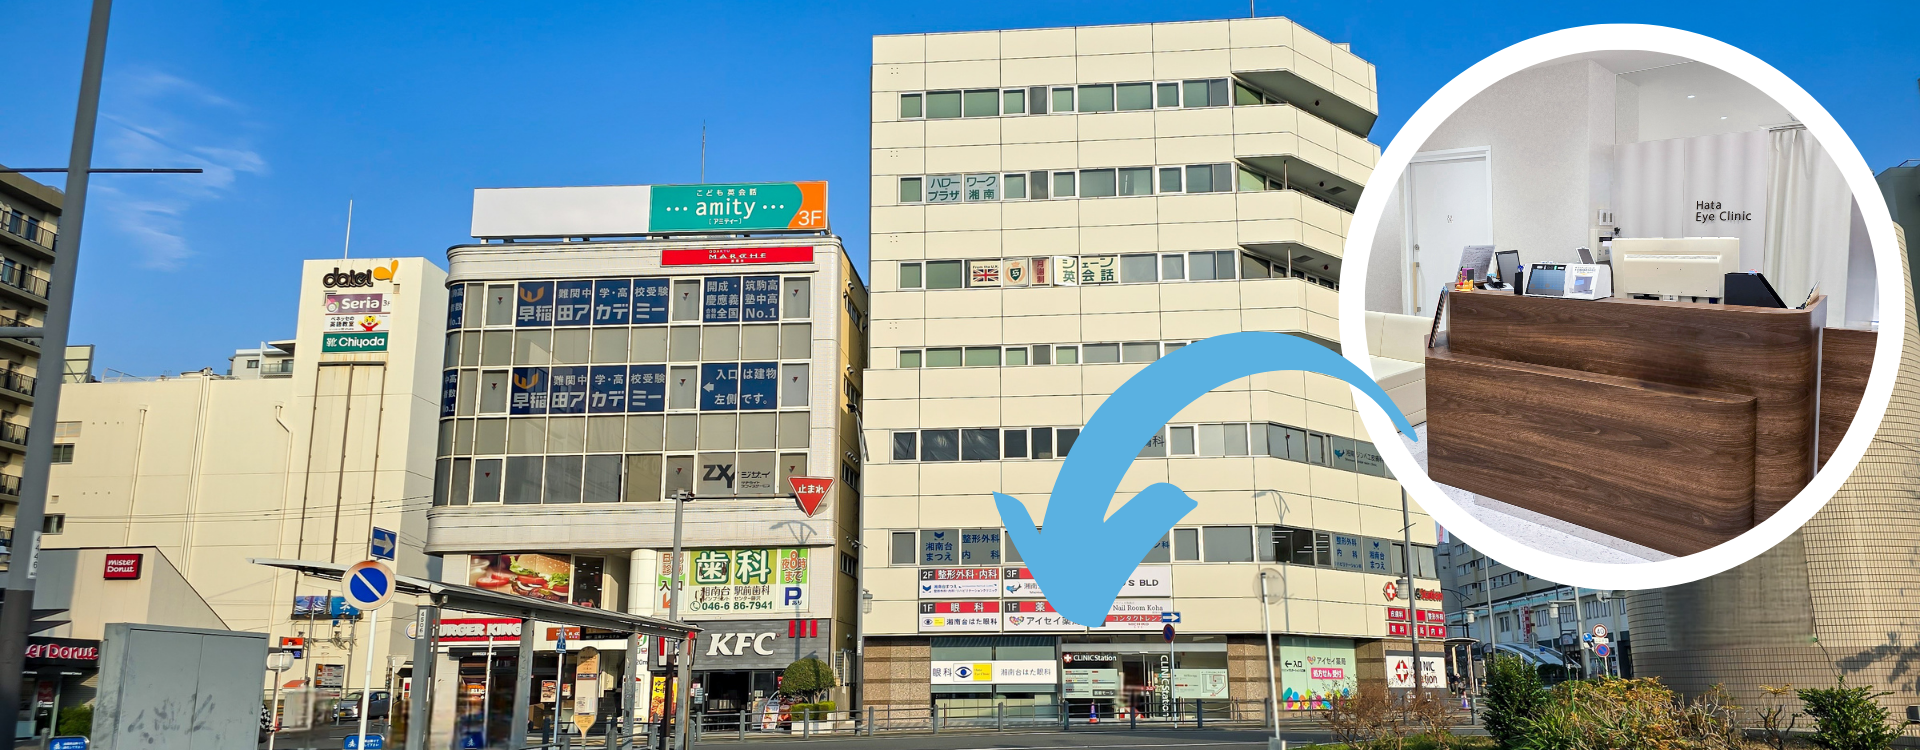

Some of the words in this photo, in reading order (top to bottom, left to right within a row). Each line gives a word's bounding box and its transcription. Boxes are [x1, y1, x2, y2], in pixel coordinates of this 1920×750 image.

[930, 176, 996, 188] ハローワーク
[696, 188, 757, 197] こども英会話
[696, 198, 756, 219] amity
[1696, 200, 1722, 210] Hata
[798, 210, 822, 226] 3F
[1695, 212, 1715, 224] Eye
[1719, 211, 1752, 221] Clinic
[1063, 268, 1114, 282] 英会話
[341, 296, 380, 310] Seria
[706, 293, 778, 306] 慶應義塾中高
[518, 303, 665, 321] 早稲田アカデミー
[338, 336, 385, 348] Chiyoda
[715, 368, 776, 380] 入口は建物
[512, 390, 662, 408] 早稲田アカデミー
[797, 484, 826, 494] 止まれ
[961, 534, 1000, 543] 整形外科
[1336, 536, 1357, 547] 整形外科
[925, 542, 953, 551] 湘南台
[925, 552, 953, 561] まつえ
[1369, 551, 1385, 561] 湘南台
[107, 565, 136, 573] Donut
[695, 550, 772, 585] 歯科
[1370, 560, 1386, 571] まつえ
[785, 570, 803, 583] まで
[922, 571, 933, 580] 2F
[937, 569, 998, 580] 整形外科・内科
[1006, 570, 1017, 579] 3F
[1140, 579, 1159, 587] BLD
[784, 587, 802, 606] P
[922, 603, 933, 613] 1F
[1007, 602, 1018, 612] 1F
[946, 617, 997, 625] 湘南台はた眼科
[432, 623, 486, 636] URGER
[487, 623, 521, 636] KING
[706, 632, 776, 656] KFC
[45, 644, 99, 660] Donut
[1317, 657, 1347, 665] アイセイ薬局
[933, 667, 952, 677] 眼科
[1001, 668, 1051, 676] 湘南台はた眼科
